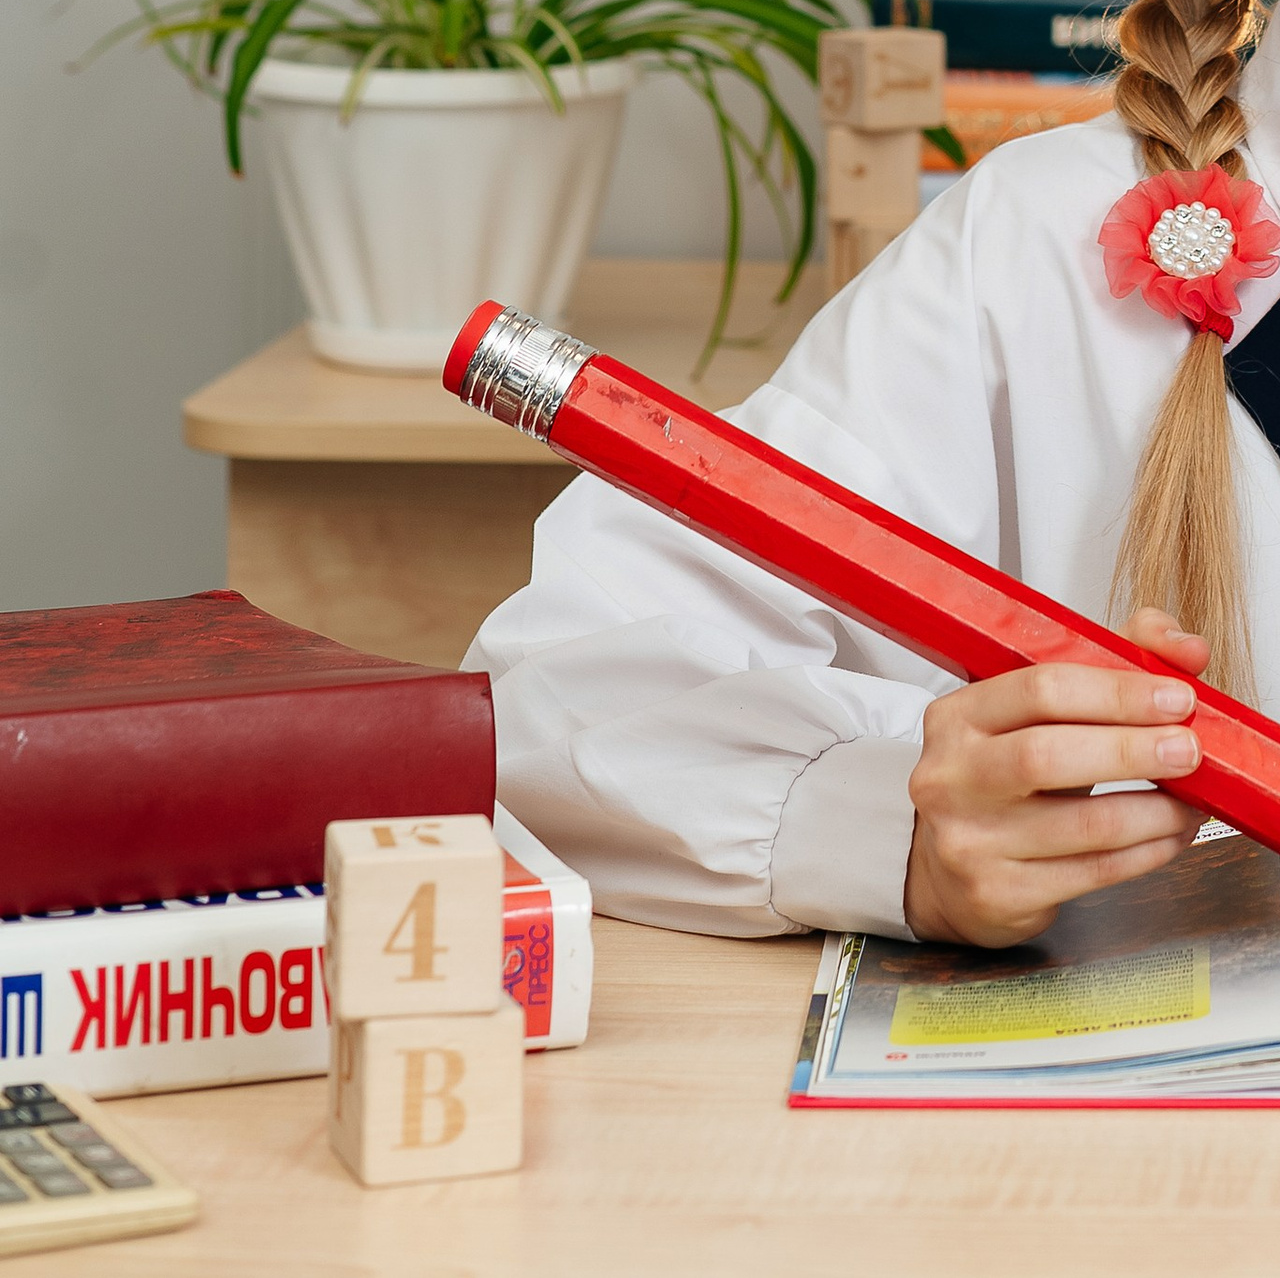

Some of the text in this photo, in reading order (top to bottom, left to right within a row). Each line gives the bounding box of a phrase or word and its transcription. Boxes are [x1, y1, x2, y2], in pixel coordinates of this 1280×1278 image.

[382, 881, 449, 983] 4
[528, 923, 549, 1006] ПРЕСС
[69, 946, 331, 1053] ВОЧНИК
